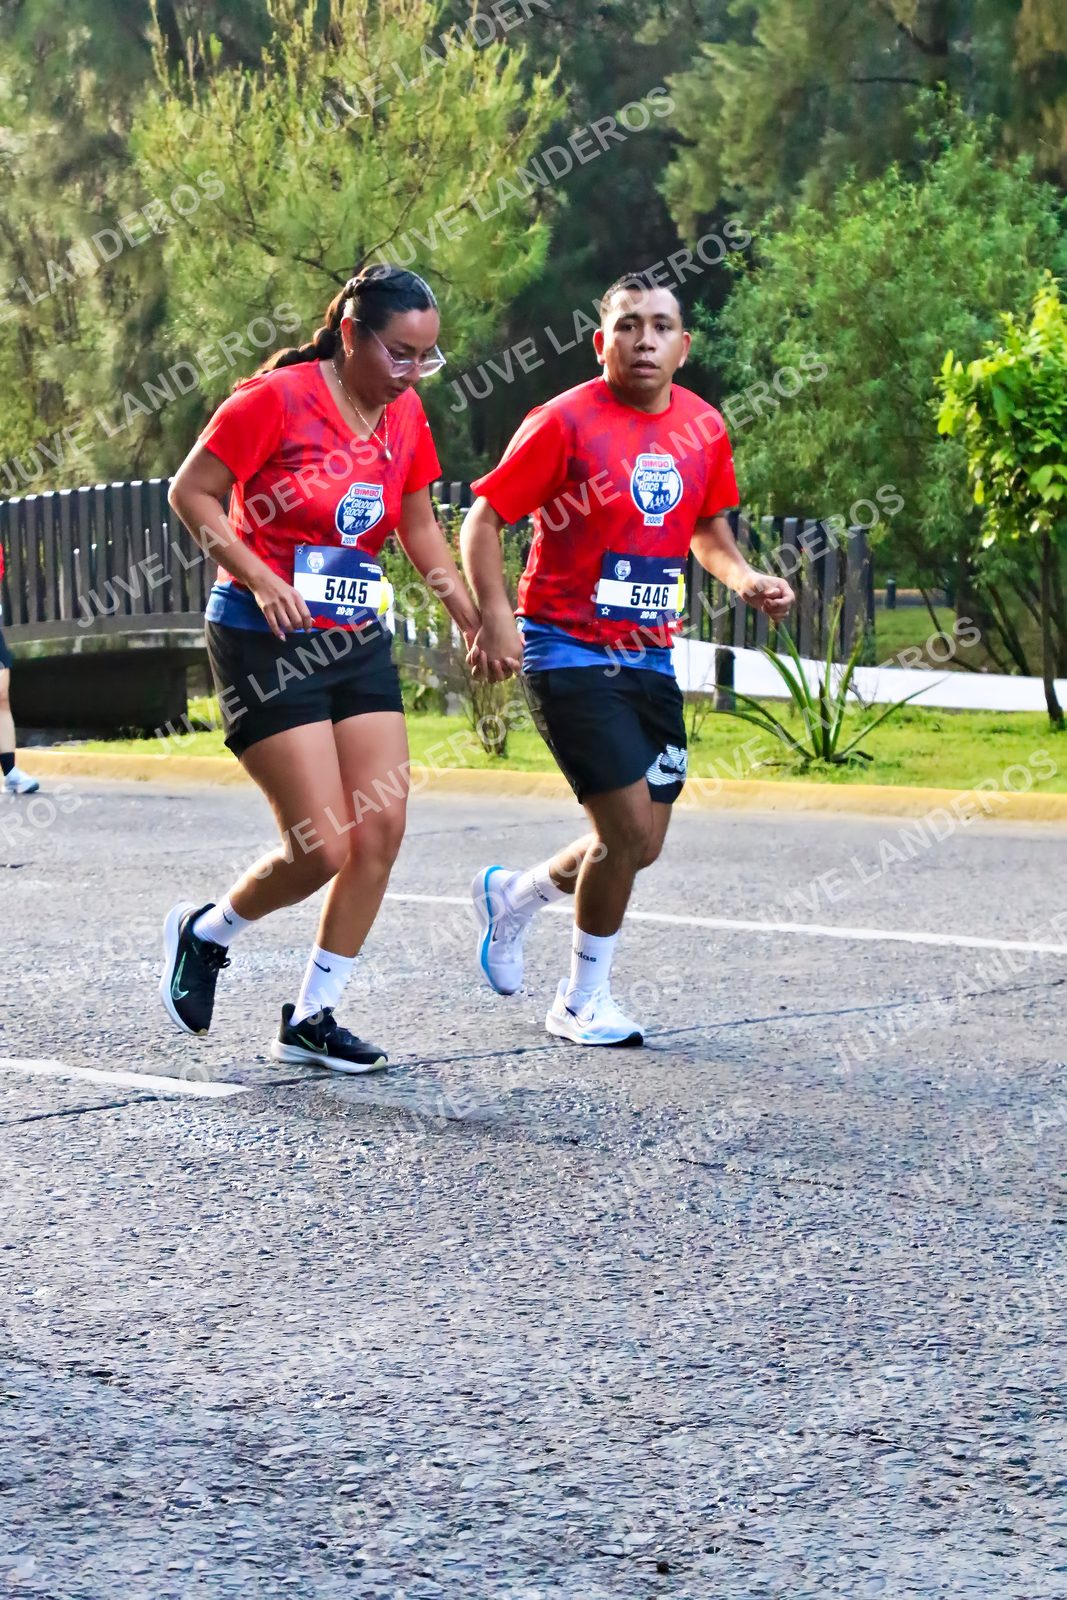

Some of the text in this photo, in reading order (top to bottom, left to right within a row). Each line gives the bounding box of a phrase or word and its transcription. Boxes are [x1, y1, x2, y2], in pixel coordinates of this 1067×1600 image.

[643, 471, 670, 482] Global
[639, 482, 660, 491] Race
[325, 578, 368, 604] 5445
[630, 585, 669, 607] 5446
